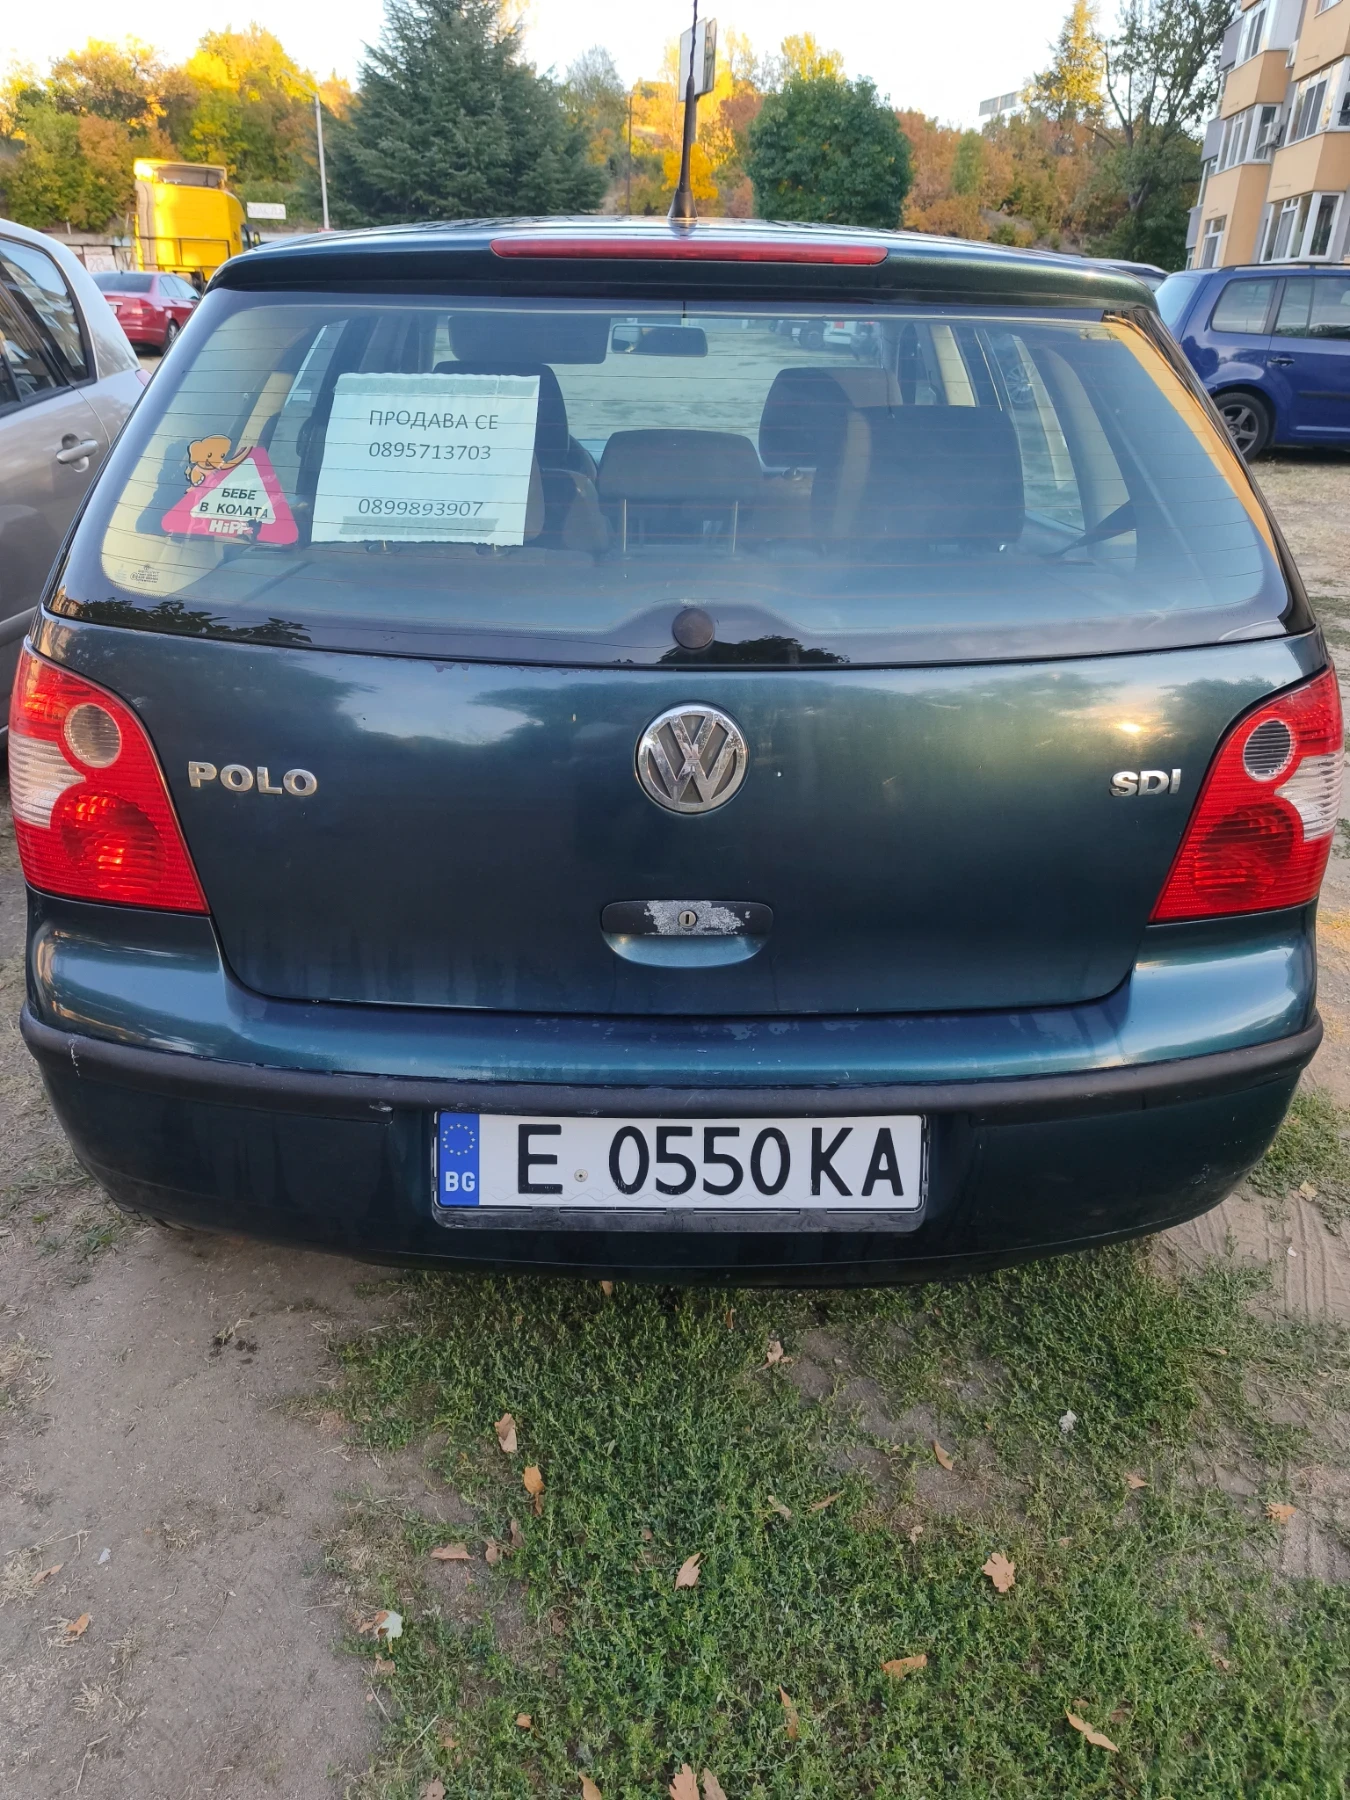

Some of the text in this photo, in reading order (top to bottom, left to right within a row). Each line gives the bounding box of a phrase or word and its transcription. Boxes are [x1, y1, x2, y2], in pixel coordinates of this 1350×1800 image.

[369, 409, 499, 431] ПРОДАВА СЕ
[368, 441, 492, 461] 0895713703
[221, 487, 257, 500] БЕБЕ
[199, 501, 268, 519] В КОЛАТА
[358, 497, 484, 518] 0899893907
[187, 760, 318, 797] POLO
[1109, 768, 1182, 797] SDI
[518, 1123, 905, 1197] E 0550 KA
[445, 1171, 475, 1193] BG
